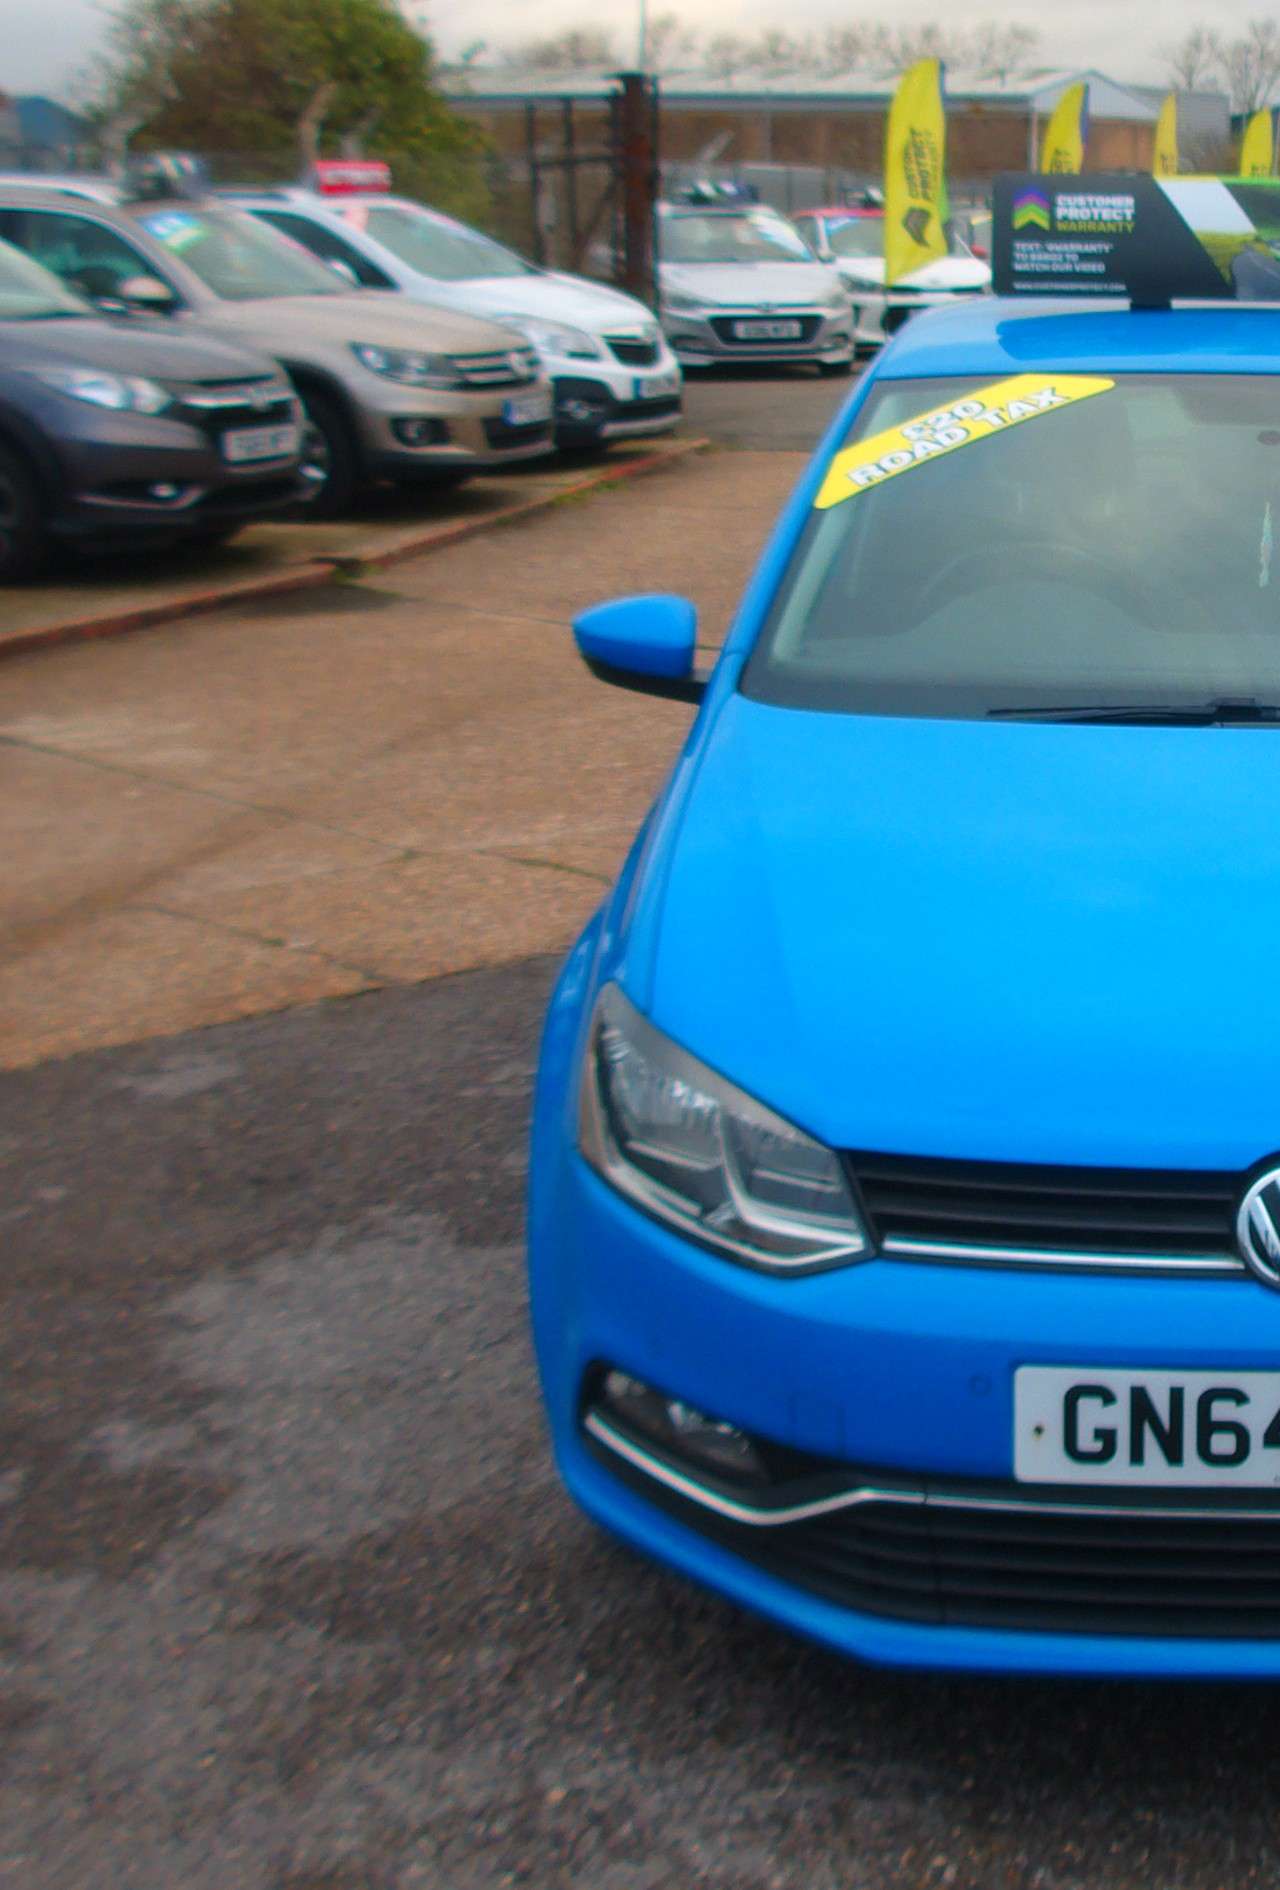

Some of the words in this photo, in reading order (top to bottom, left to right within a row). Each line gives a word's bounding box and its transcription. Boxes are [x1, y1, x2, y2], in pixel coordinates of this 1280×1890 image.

[1056, 195, 1134, 208] CUSTOMER
[1056, 208, 1134, 220] PROTECT
[1056, 221, 1134, 232] WARRANTY
[1074, 262, 1105, 273] VIDEO
[849, 425, 970, 487] ROAD
[974, 386, 1071, 427] TAX
